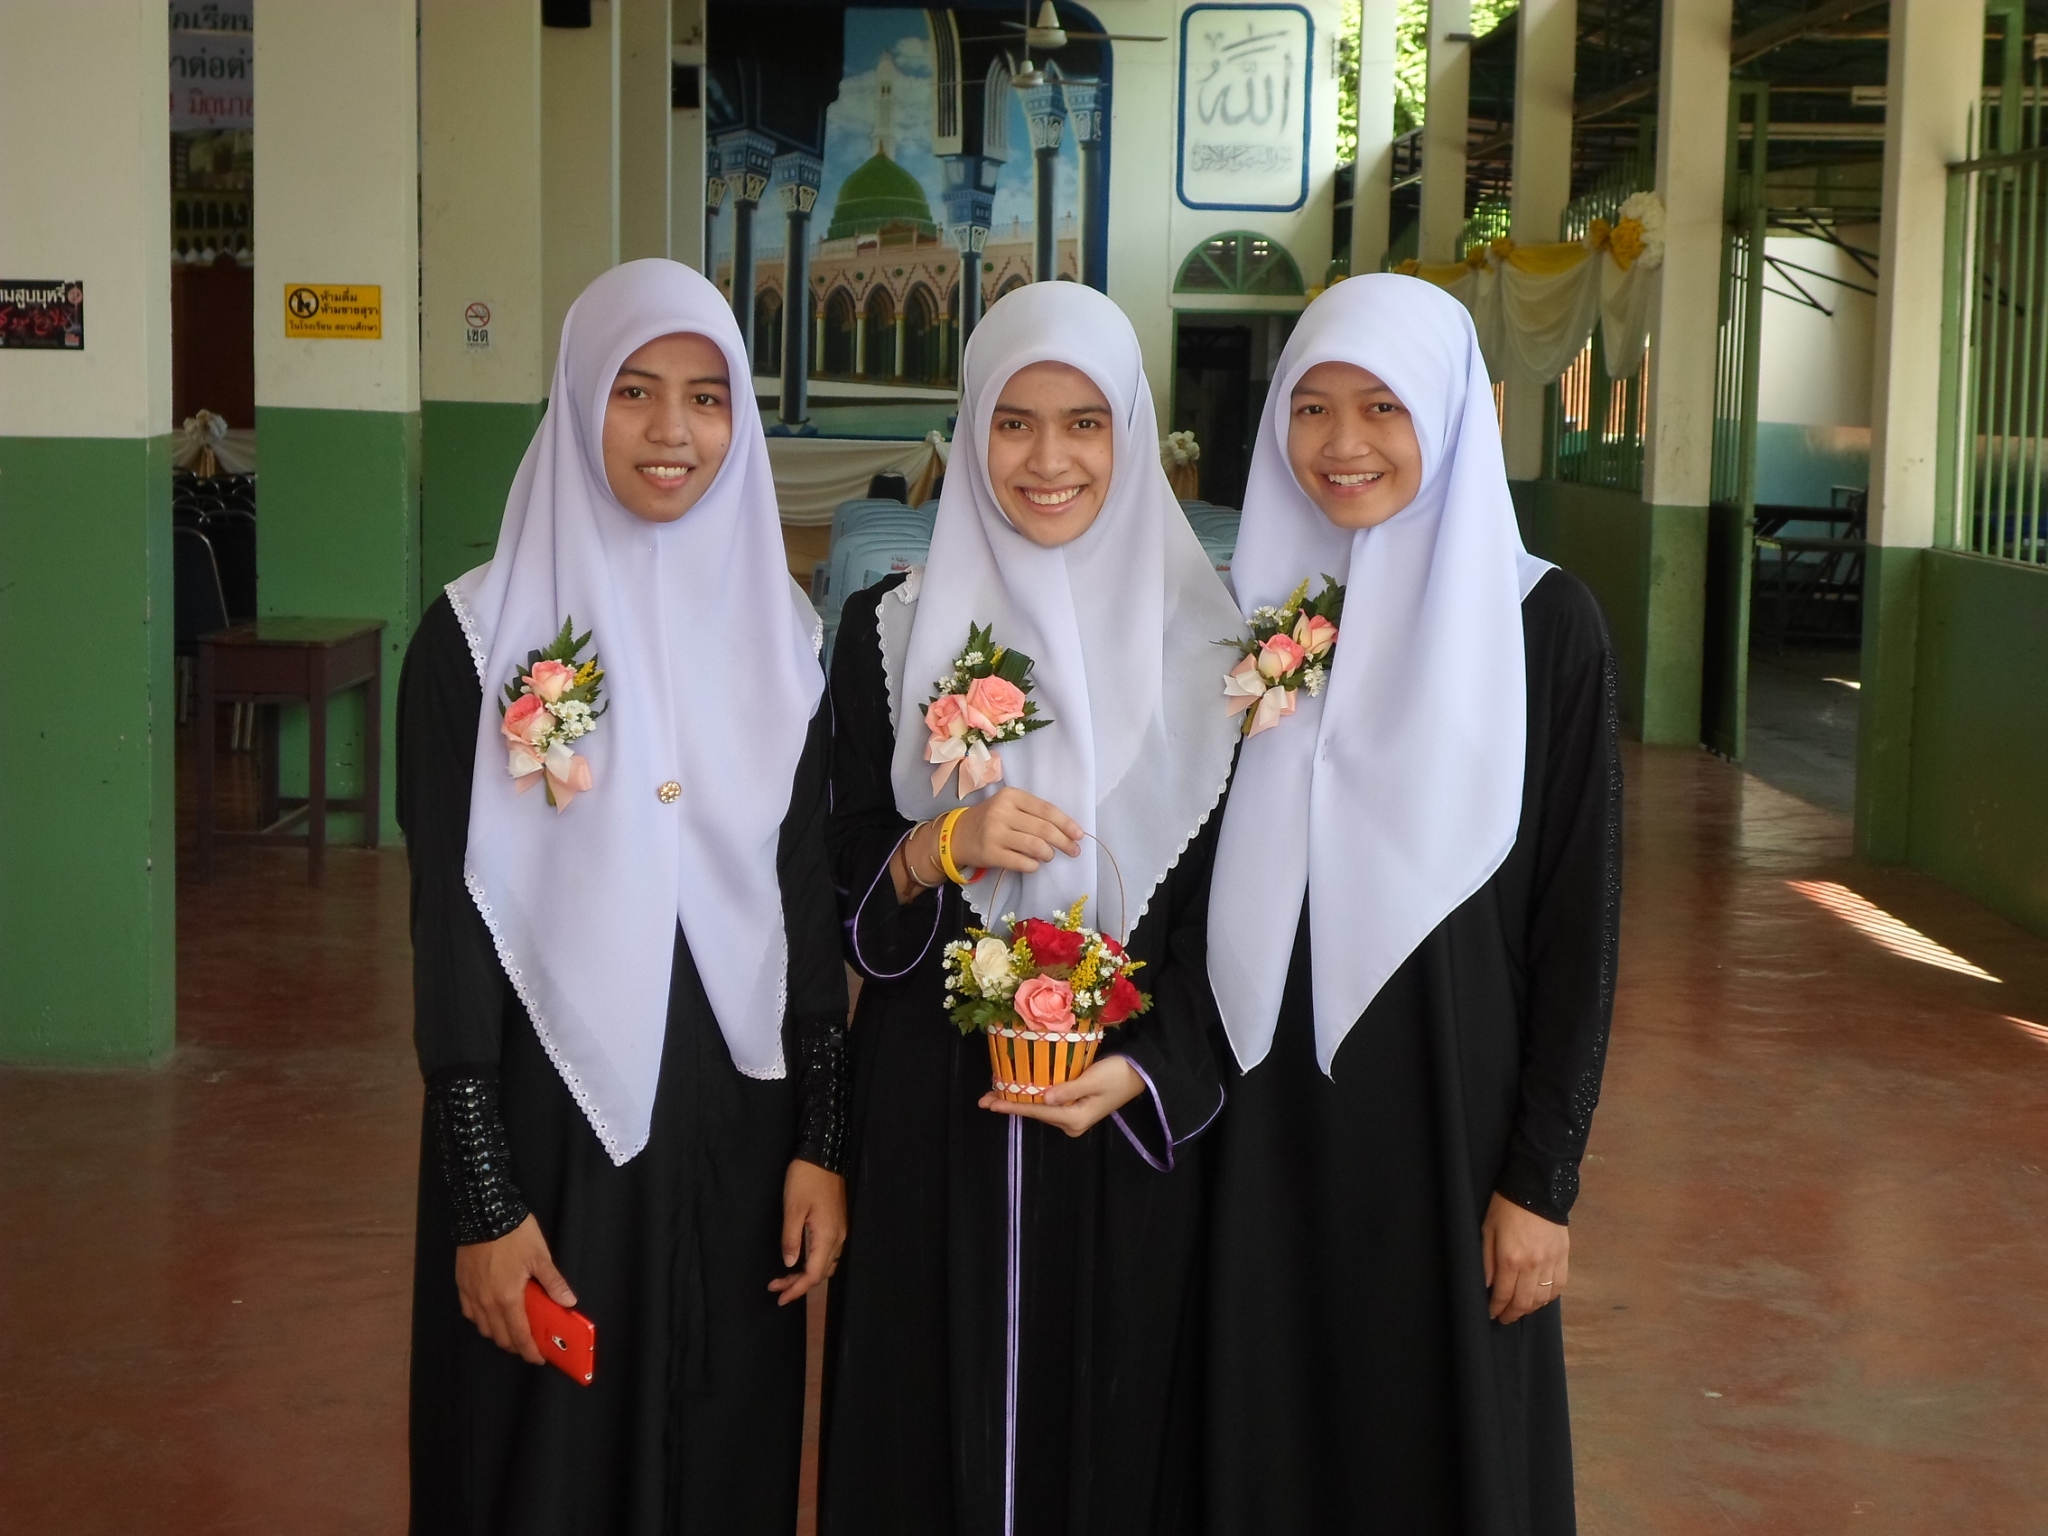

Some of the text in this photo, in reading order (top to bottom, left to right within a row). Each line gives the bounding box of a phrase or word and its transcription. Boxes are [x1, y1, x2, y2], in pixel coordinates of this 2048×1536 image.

[321, 288, 357, 302] ห้ามดื่ม
[321, 303, 378, 319] ห้ามขายสุรา
[289, 320, 378, 331] ในโรงเรียน สถานศึกษา
[466, 329, 489, 342] เขต
